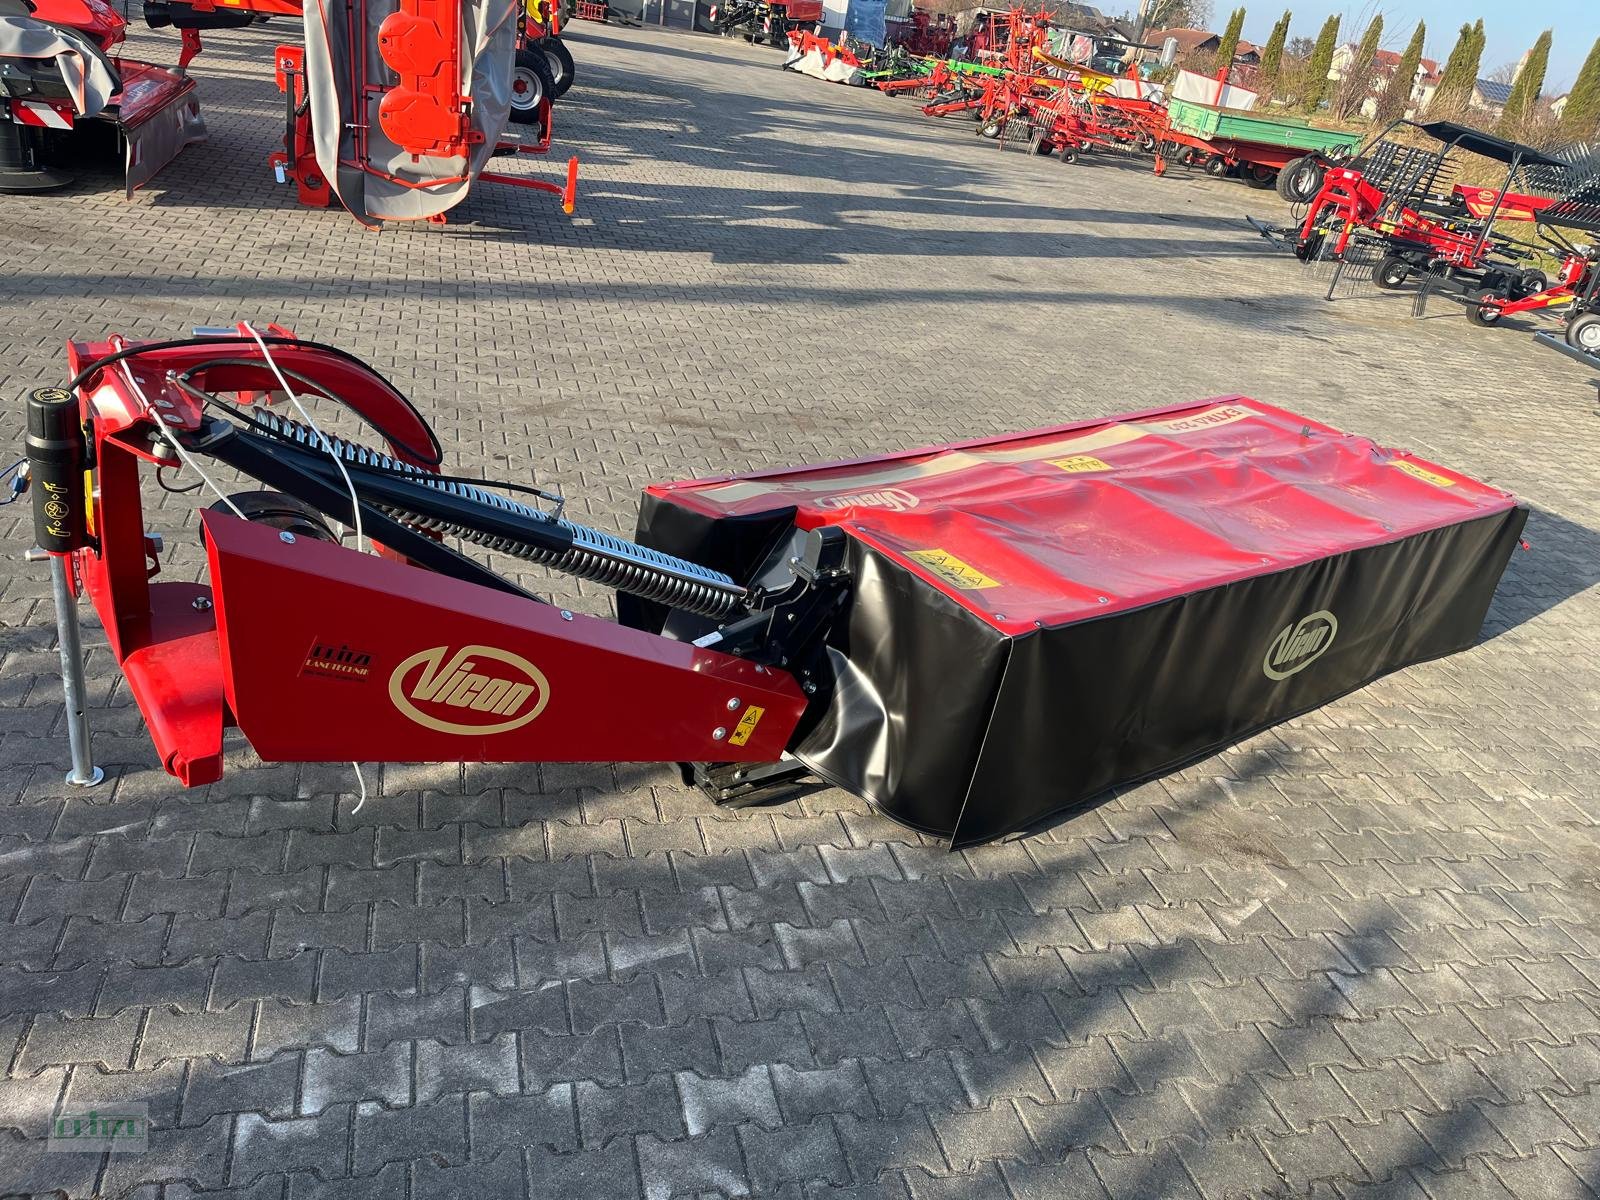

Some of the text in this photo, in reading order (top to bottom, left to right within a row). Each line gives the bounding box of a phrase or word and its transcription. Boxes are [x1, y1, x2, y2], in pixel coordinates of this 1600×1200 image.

[1192, 408, 1243, 425] EXTRA
[828, 490, 908, 512] Vicon
[1271, 618, 1332, 669] Vicon
[408, 645, 539, 717] Vicon
